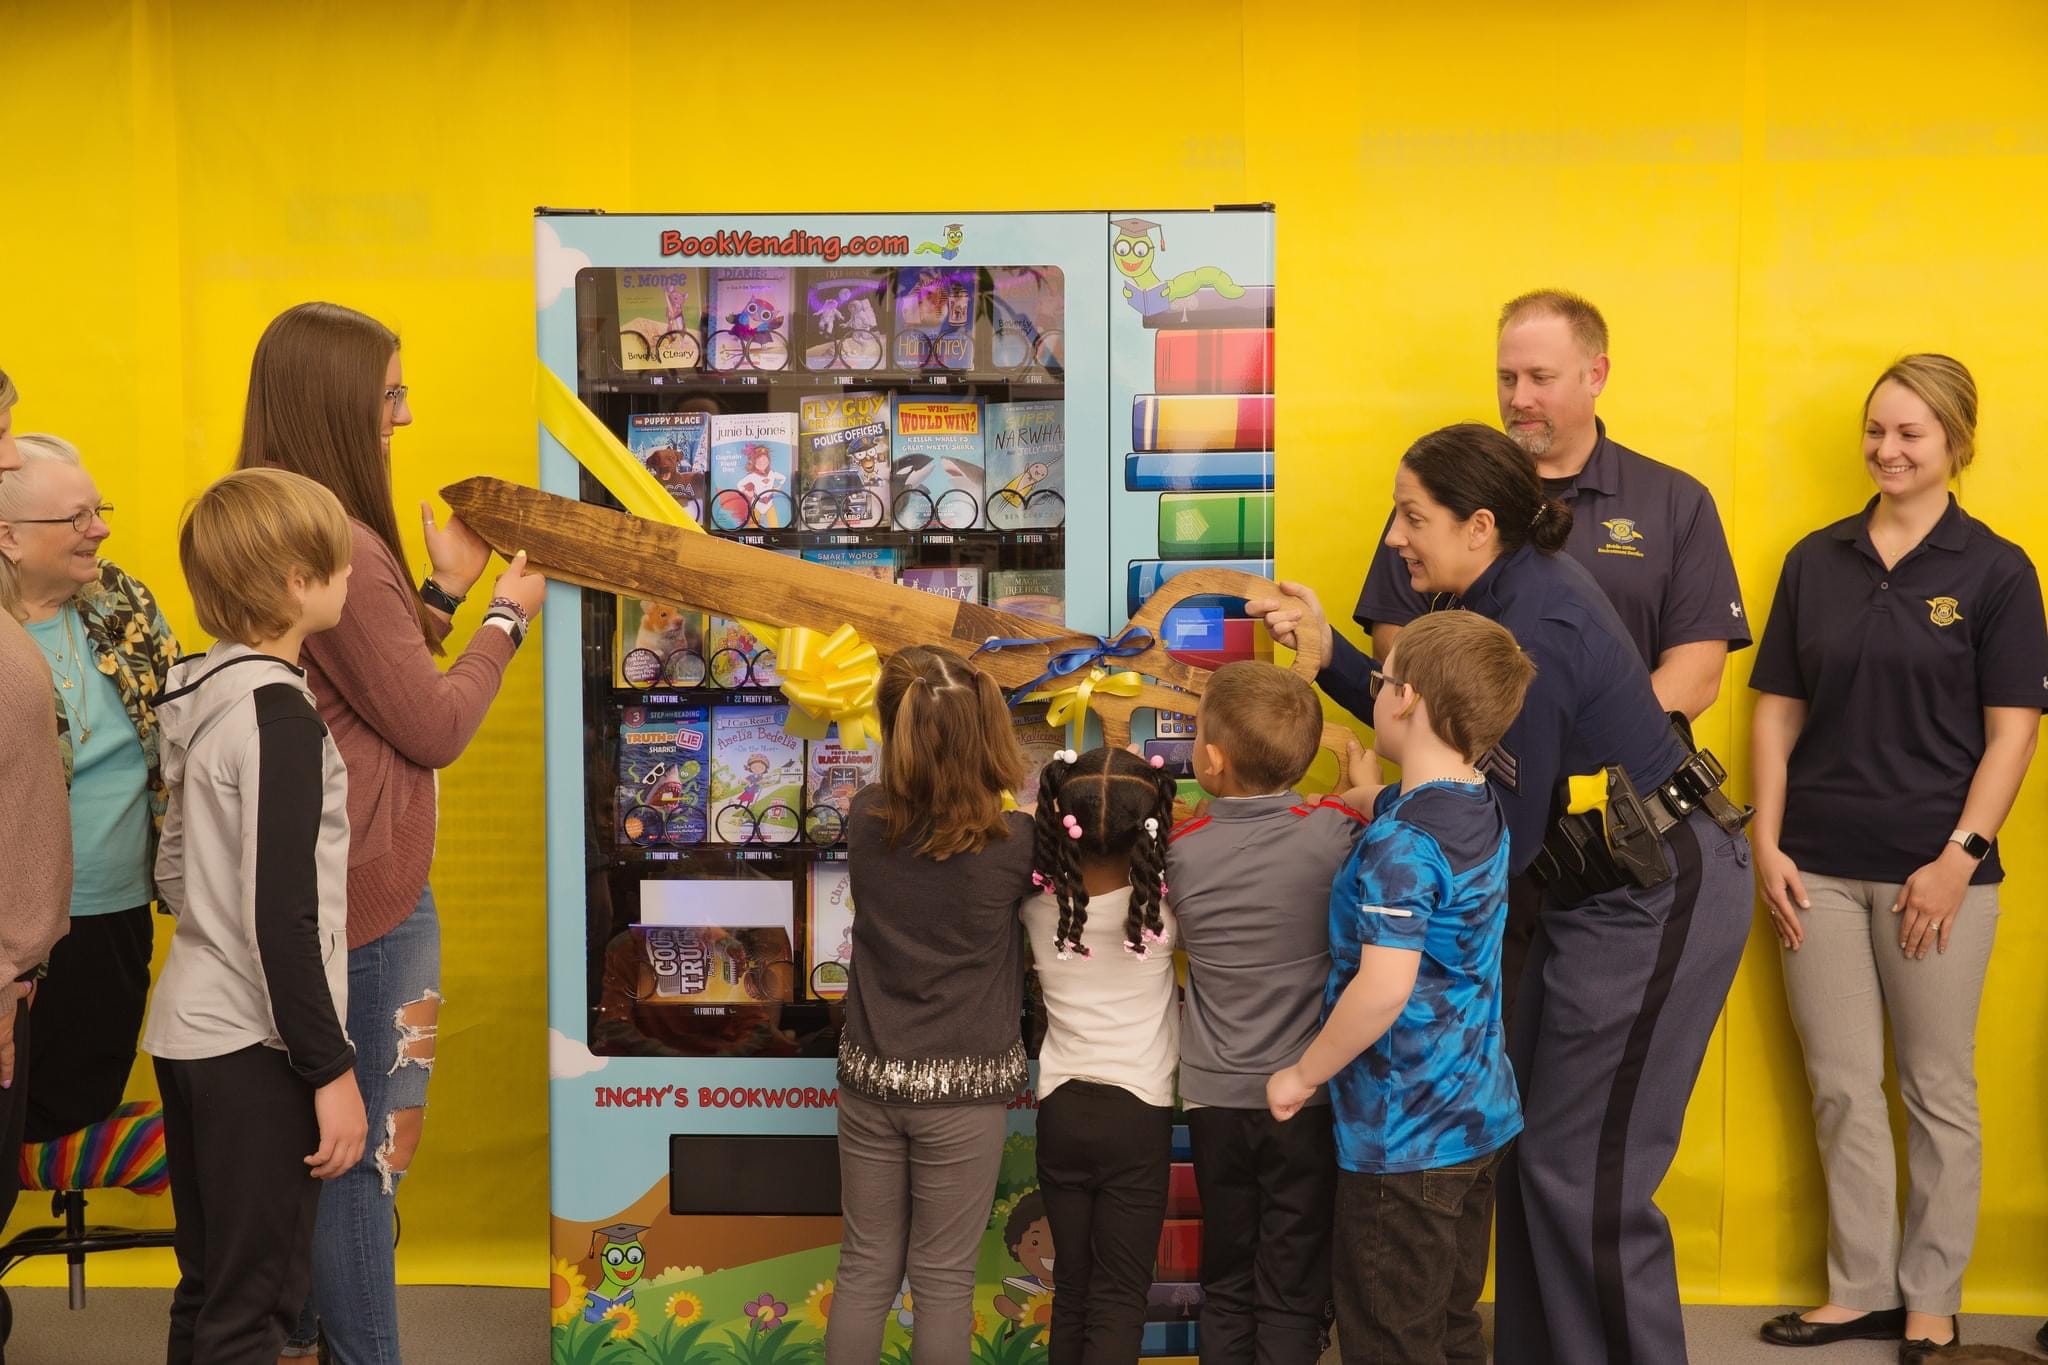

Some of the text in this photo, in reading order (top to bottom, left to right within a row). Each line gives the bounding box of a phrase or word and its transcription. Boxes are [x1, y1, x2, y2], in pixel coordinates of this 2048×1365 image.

[661, 230, 909, 261] BookVending.com
[638, 271, 688, 288] Mouse
[838, 376, 854, 385] THREE
[934, 376, 947, 385] FOUR
[803, 395, 885, 421] FLY GUY
[927, 405, 949, 413] WHO
[644, 417, 672, 426] PUPPY
[674, 416, 701, 425] PLACE
[900, 410, 977, 435] WOULD WIN?
[716, 427, 743, 441] junie
[754, 425, 786, 438] jones
[813, 424, 883, 449] POLICE OFFICERS
[745, 536, 764, 544] TWELVE
[836, 535, 860, 544] THIRTEEN
[929, 535, 954, 544] FOURTEEN
[1023, 534, 1043, 543] FIFTEEN
[817, 552, 846, 561] SMART
[632, 711, 641, 722] 3
[626, 731, 664, 745] TRUTH
[680, 733, 700, 746] LIE
[717, 726, 798, 750] Amelia Bedelia
[834, 852, 848, 860] THIRT
[594, 1083, 838, 1109] INCHY'S BOOKWORM
